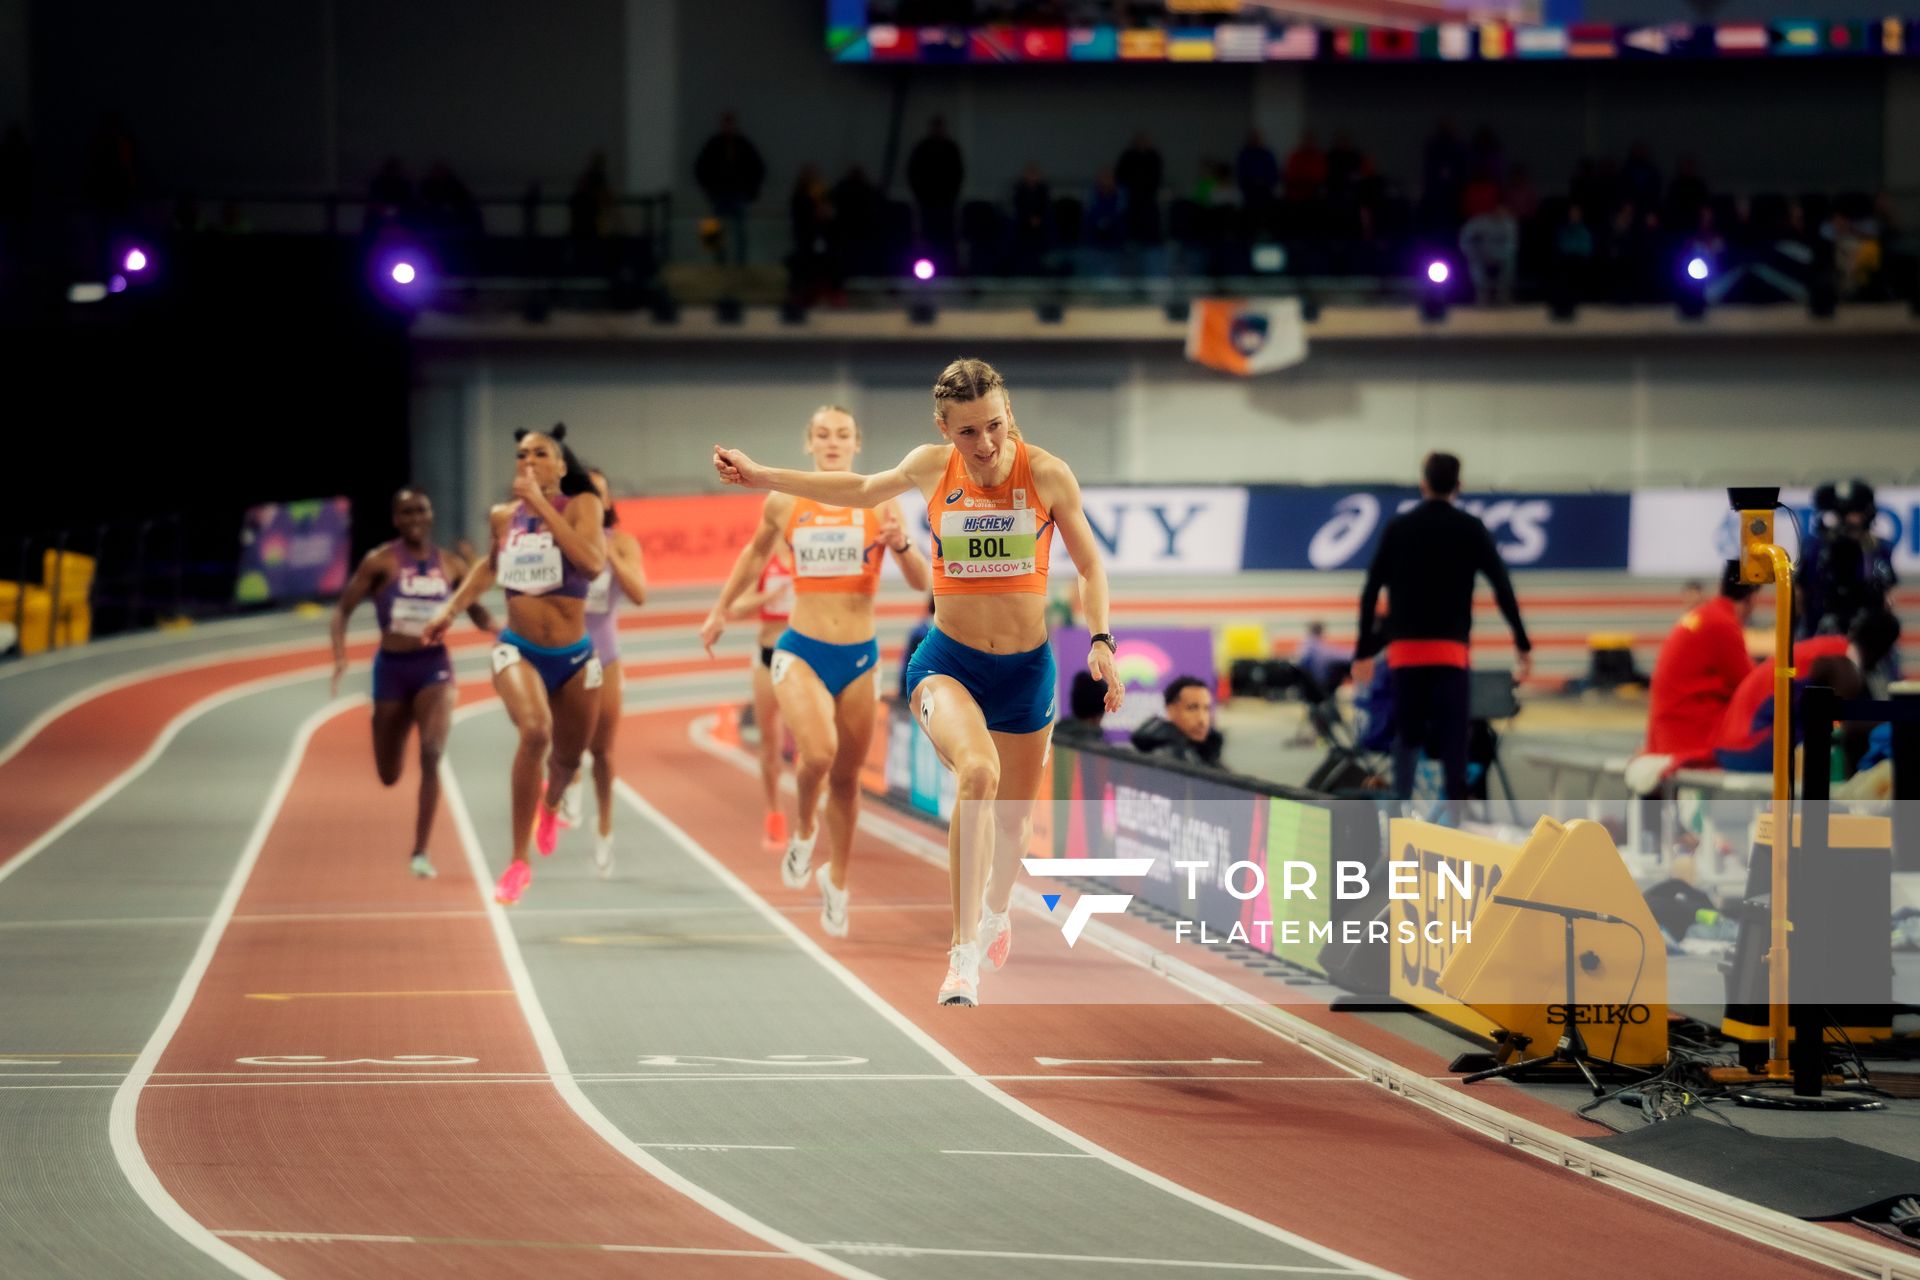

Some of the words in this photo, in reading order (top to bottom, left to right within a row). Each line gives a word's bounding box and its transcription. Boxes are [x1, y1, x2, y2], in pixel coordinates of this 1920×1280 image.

[963, 516, 1015, 532] HI-CHEW
[800, 546, 858, 562] KLAVER
[969, 538, 1011, 558] BOL
[503, 566, 558, 582] HOLMES
[966, 563, 1020, 573] GLASGOW
[1021, 561, 1032, 570] 24
[1547, 1004, 1650, 1025] SEIKO
